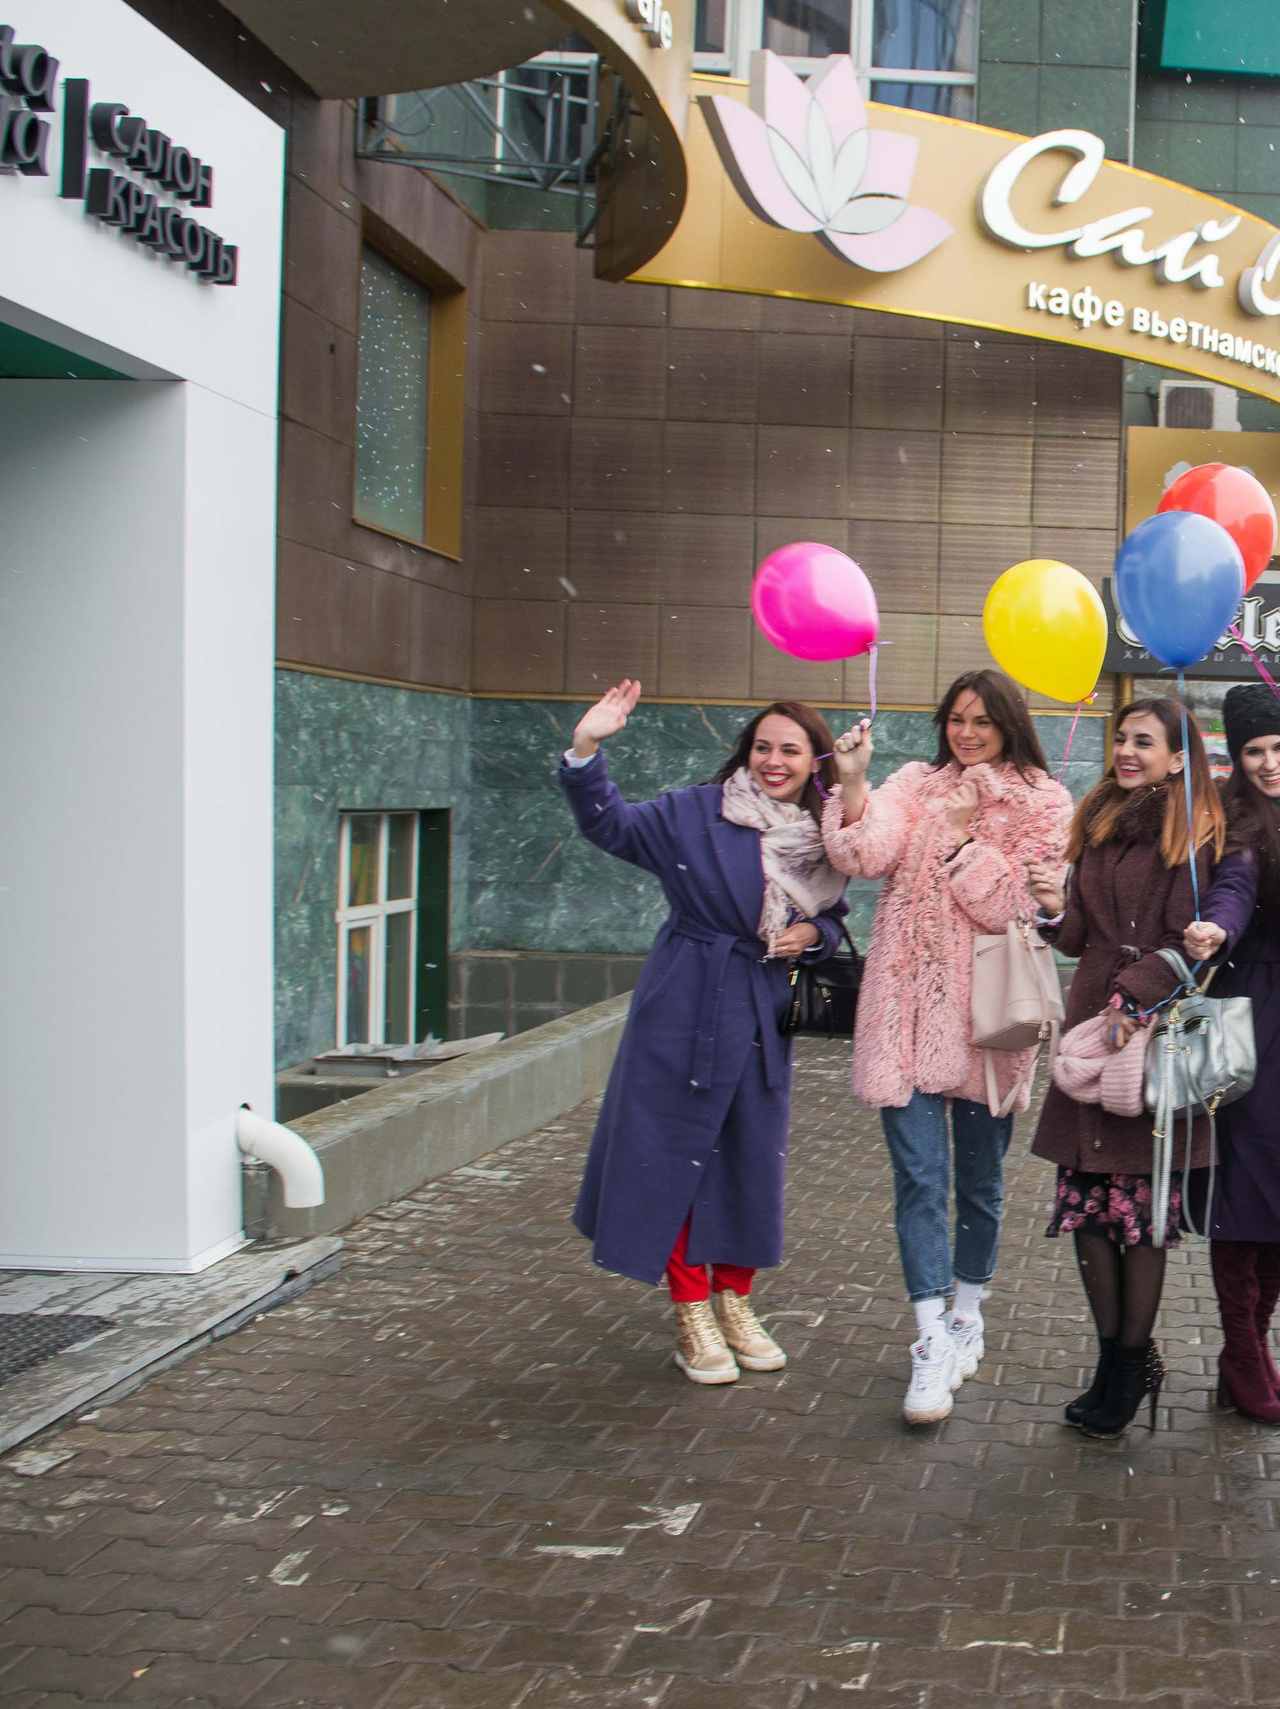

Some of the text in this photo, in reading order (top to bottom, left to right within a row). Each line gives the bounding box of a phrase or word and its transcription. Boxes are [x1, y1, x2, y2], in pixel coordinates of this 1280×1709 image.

[92, 103, 212, 207] САЛОН
[978, 129, 1241, 289] Сай
[1027, 281, 1125, 328] кафе
